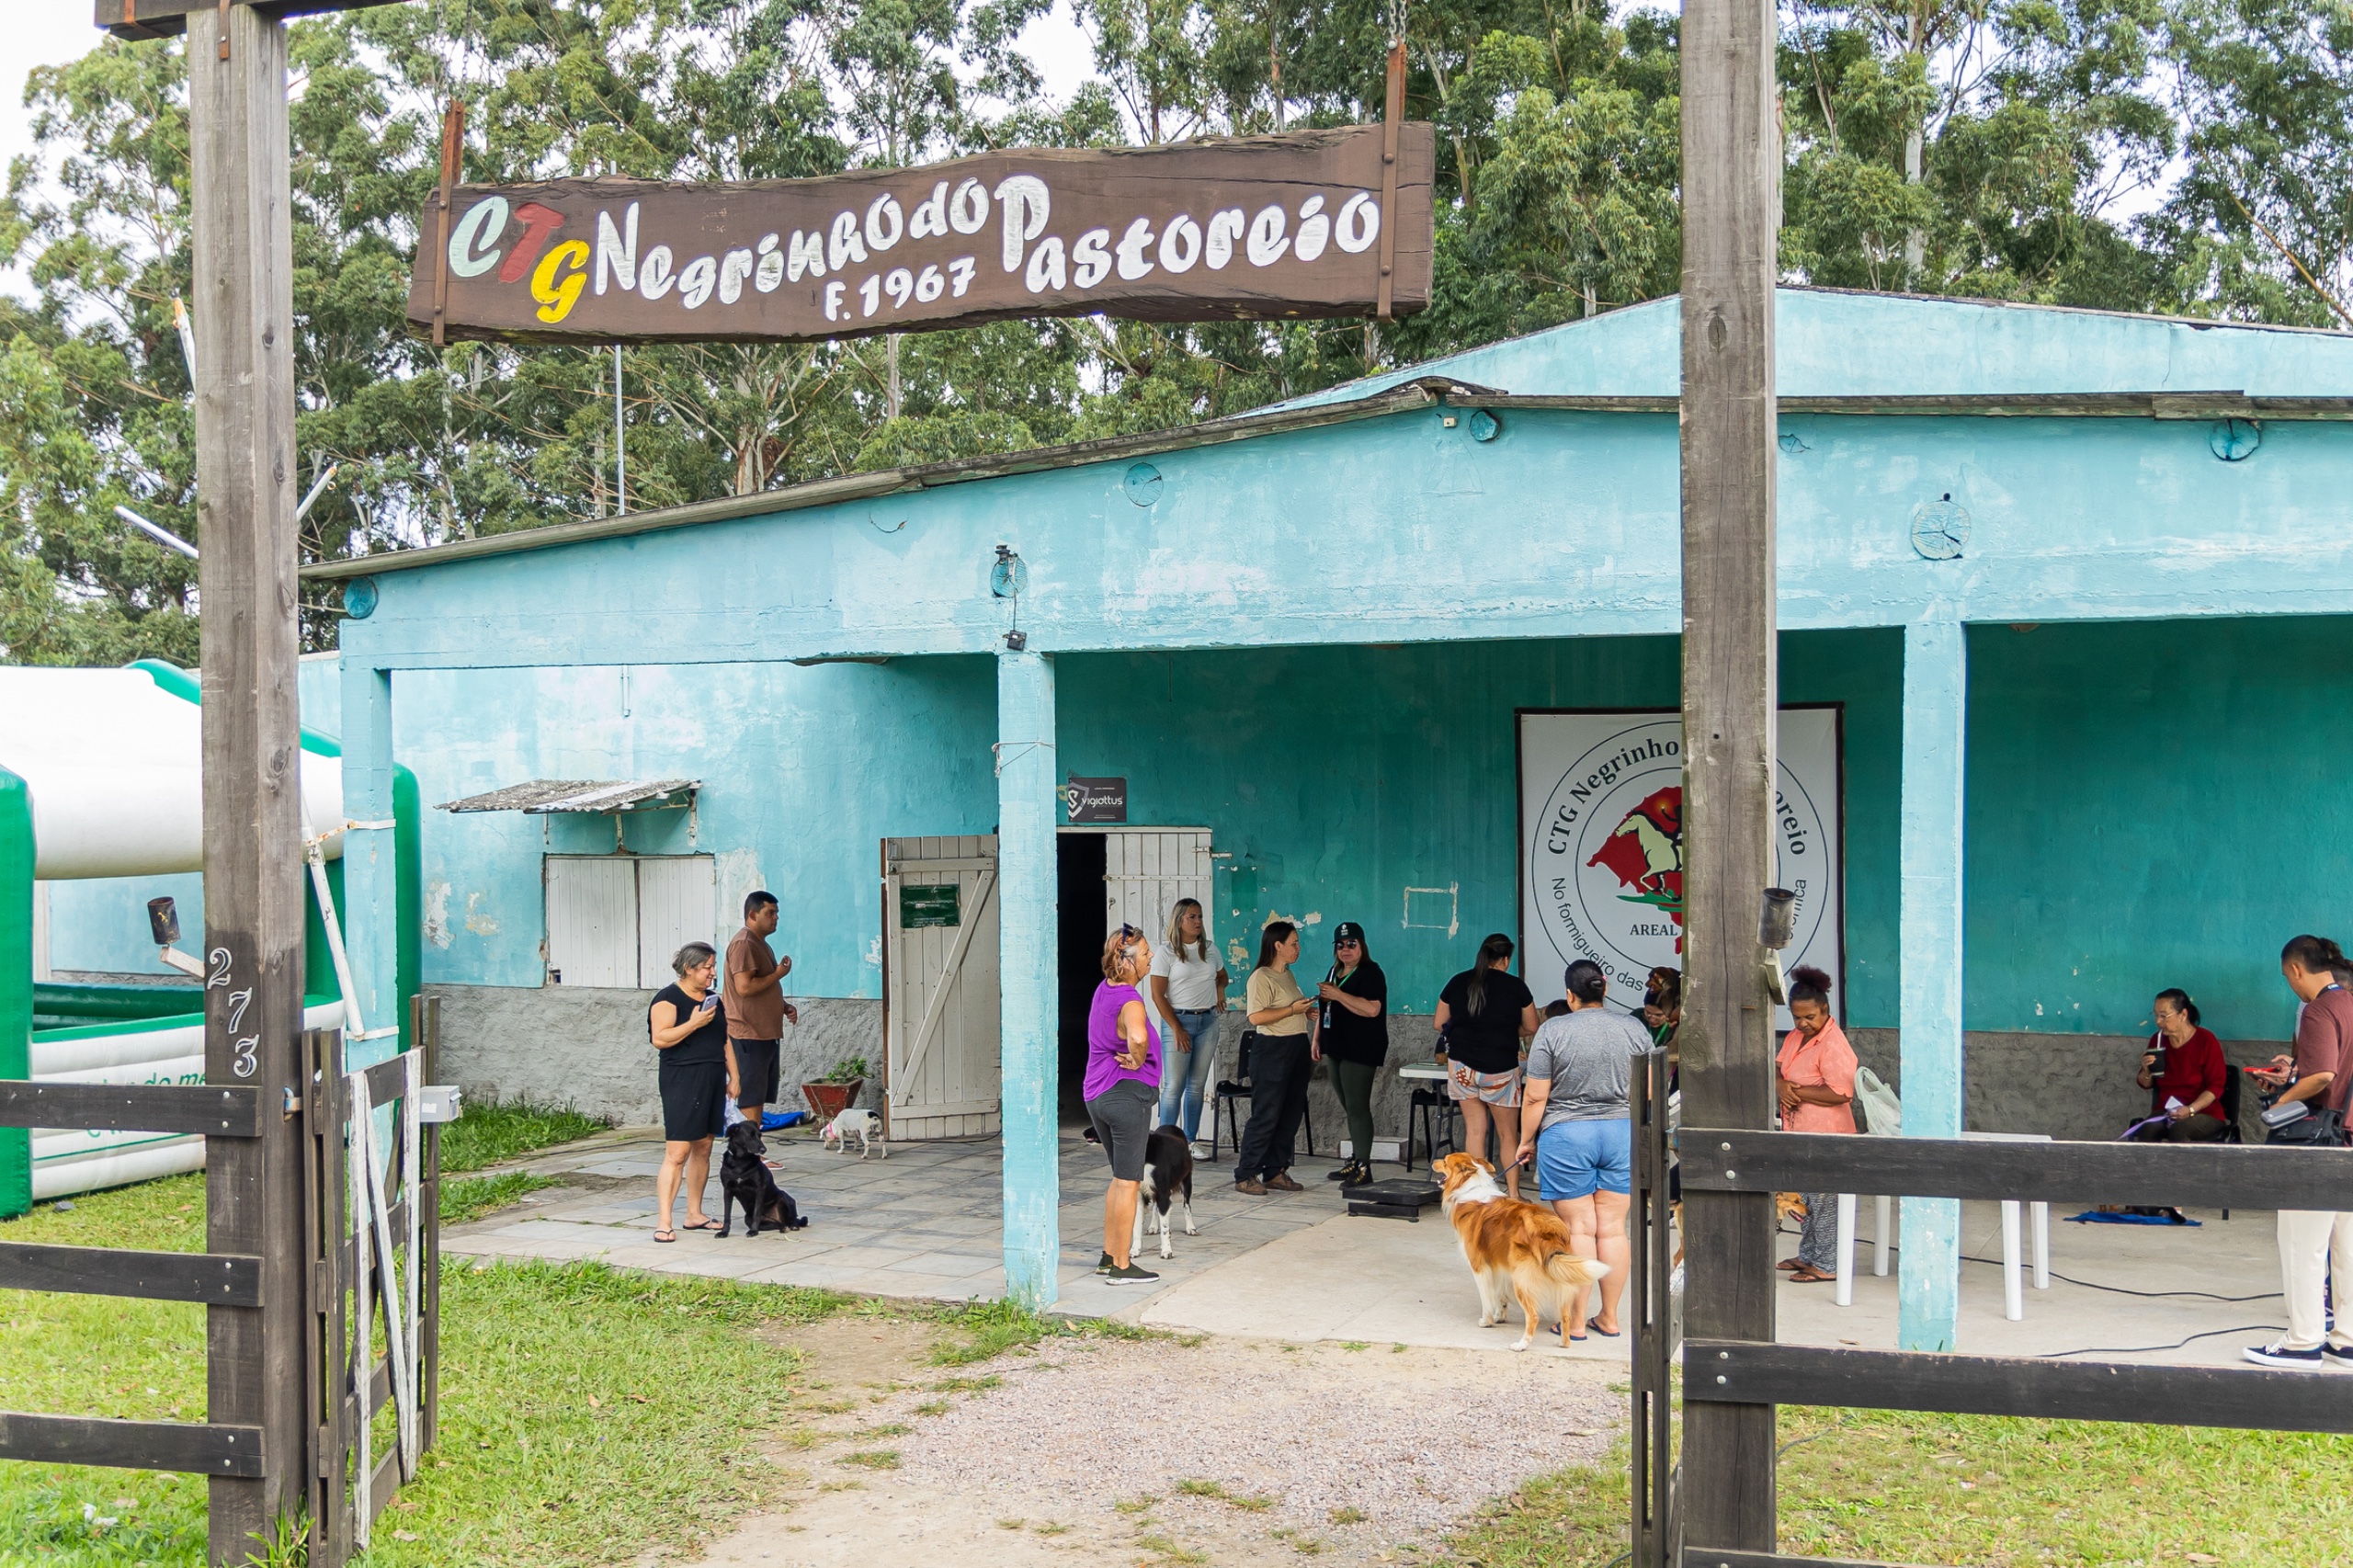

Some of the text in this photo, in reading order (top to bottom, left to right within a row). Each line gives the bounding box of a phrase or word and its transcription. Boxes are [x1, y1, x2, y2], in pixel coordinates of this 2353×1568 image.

[449, 195, 590, 324] CTG
[995, 174, 1380, 294] Pastoreio
[1548, 804, 1579, 855] CTG
[1568, 738, 1680, 805] Negrinho
[1552, 877, 1644, 992] No formigueiro das
[1630, 924, 1678, 937] AREAL
